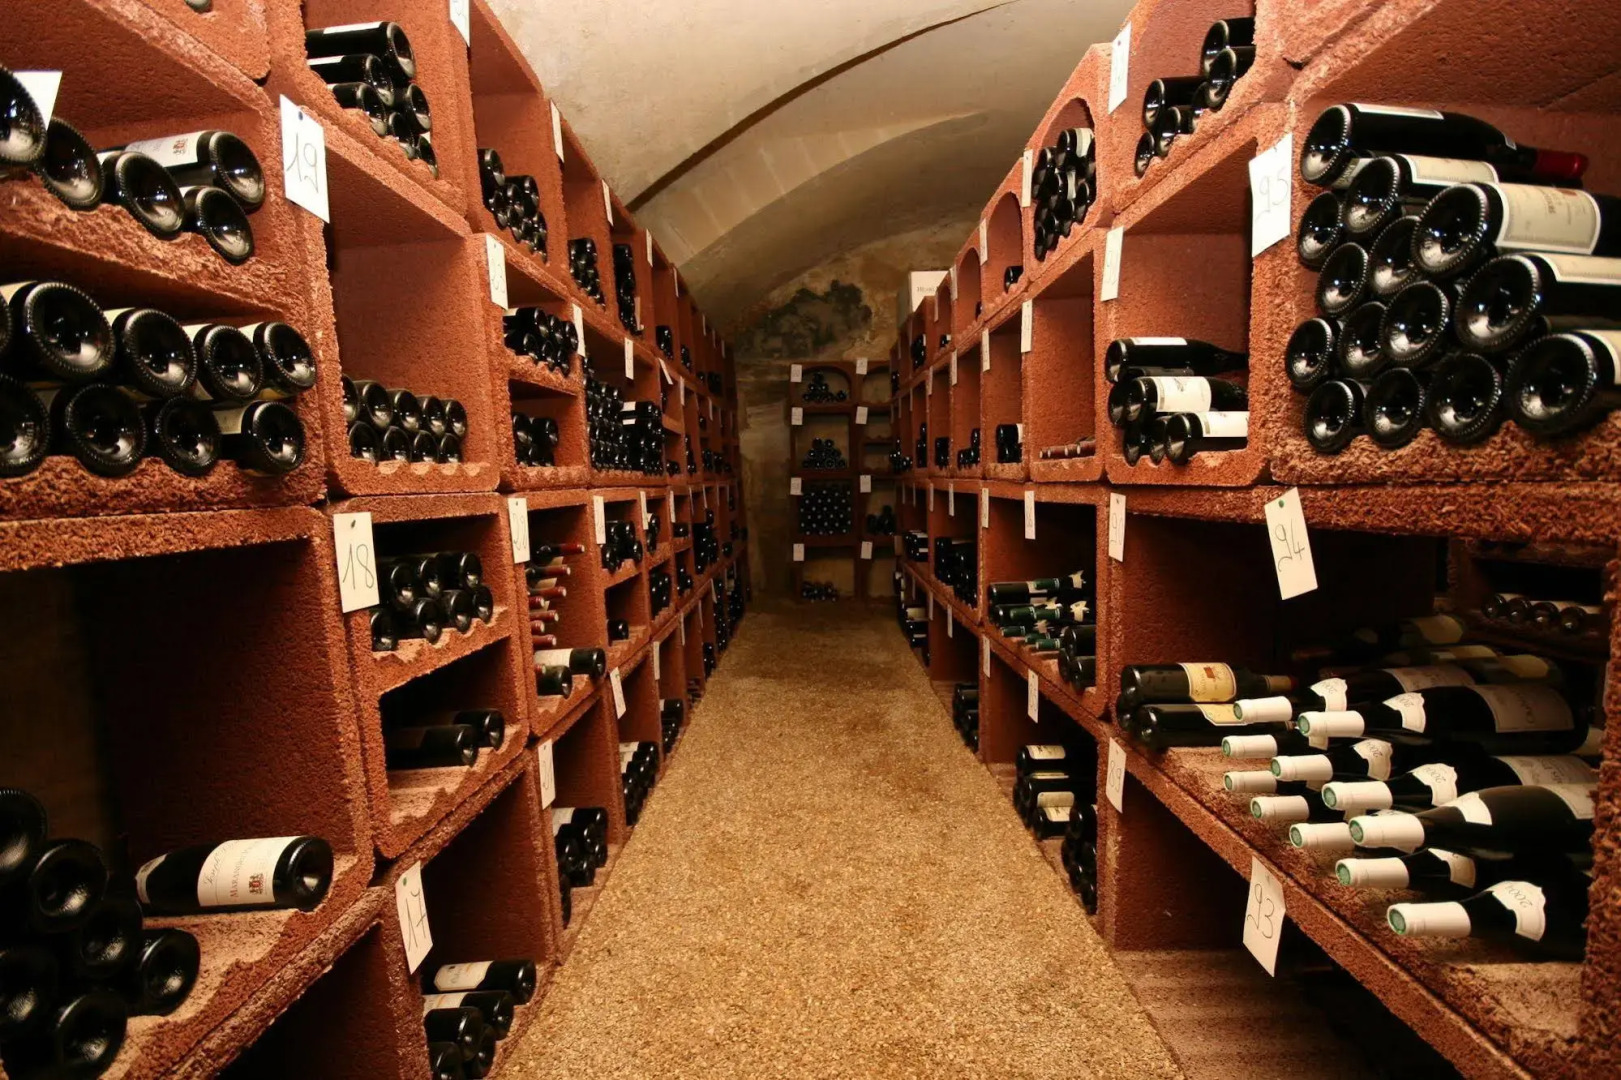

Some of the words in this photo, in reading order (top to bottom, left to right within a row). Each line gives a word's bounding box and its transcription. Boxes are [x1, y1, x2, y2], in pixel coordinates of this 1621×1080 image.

[287, 132, 320, 193] 19
[1255, 167, 1290, 223] 95
[343, 543, 375, 591] 18
[1278, 518, 1306, 573] 94
[1108, 759, 1124, 793] 89
[407, 890, 427, 951] 17
[1246, 883, 1275, 939] 93
